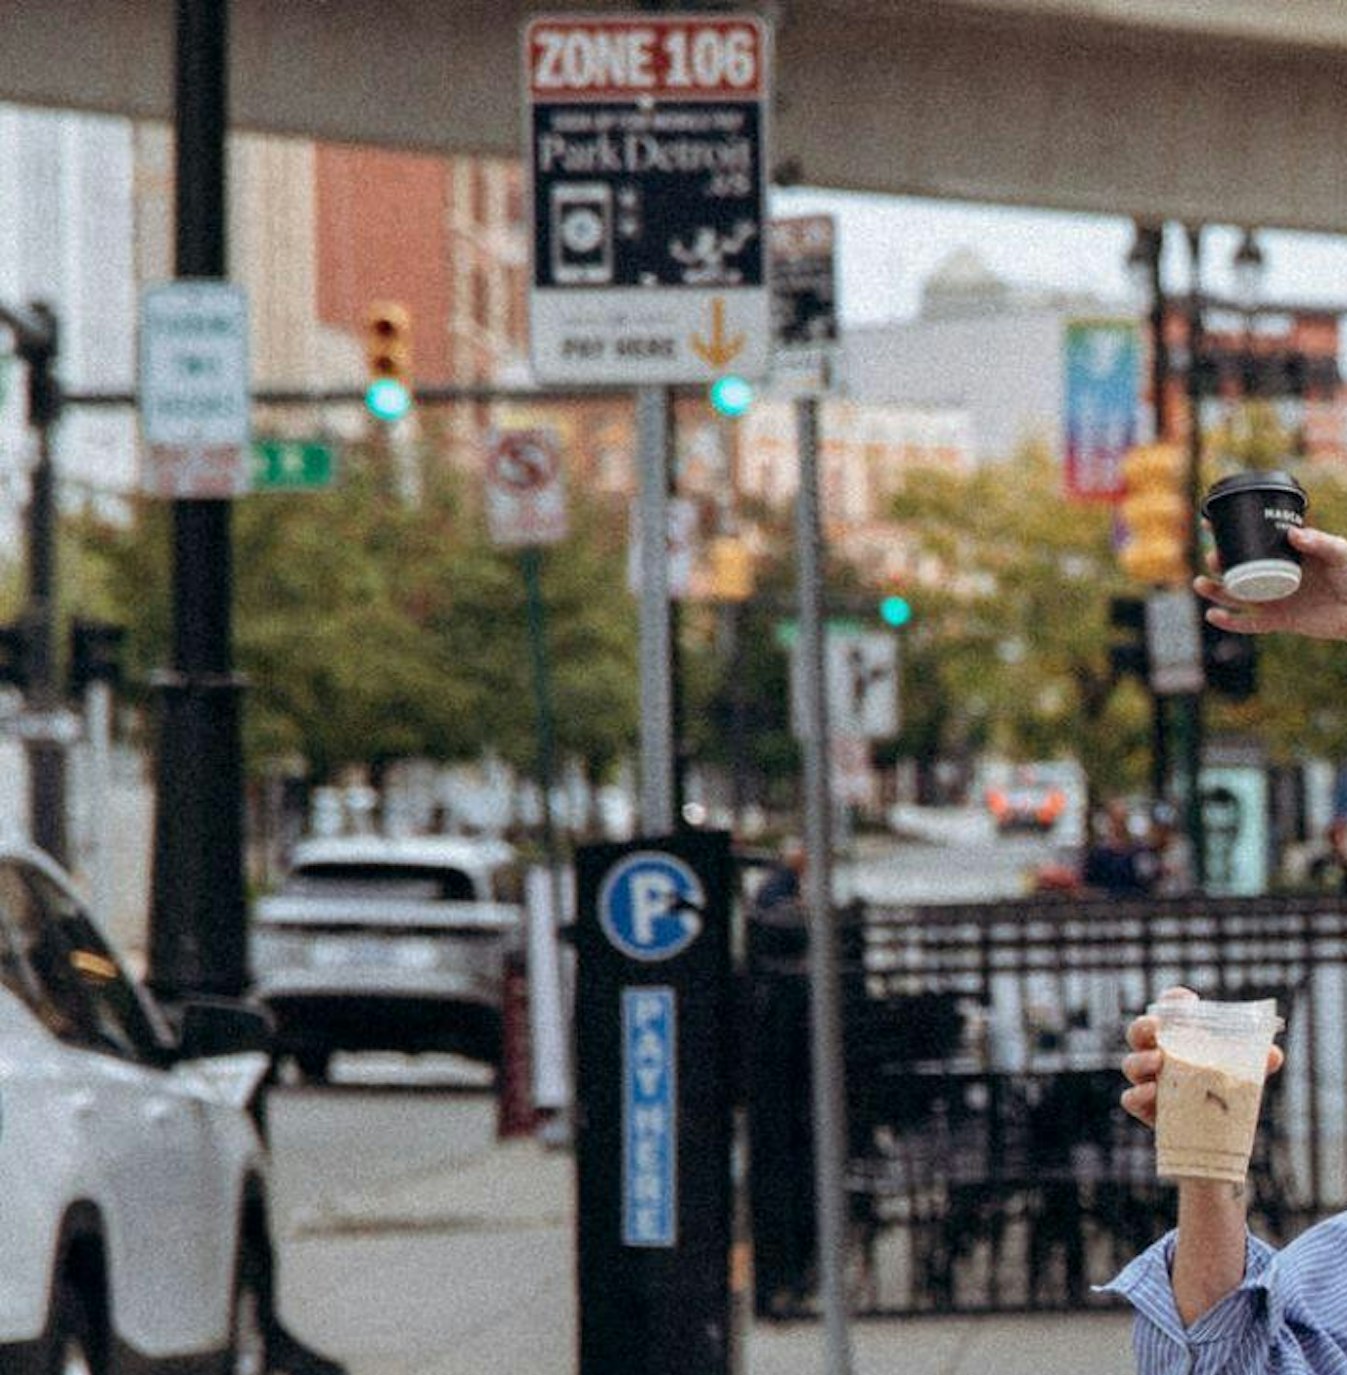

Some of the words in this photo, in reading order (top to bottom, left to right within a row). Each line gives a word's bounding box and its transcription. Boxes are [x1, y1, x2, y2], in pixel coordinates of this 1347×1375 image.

[534, 30, 656, 87] ZONE
[664, 30, 755, 87] 106
[634, 997, 665, 1097] PAY
[634, 1107, 665, 1240] HERE
